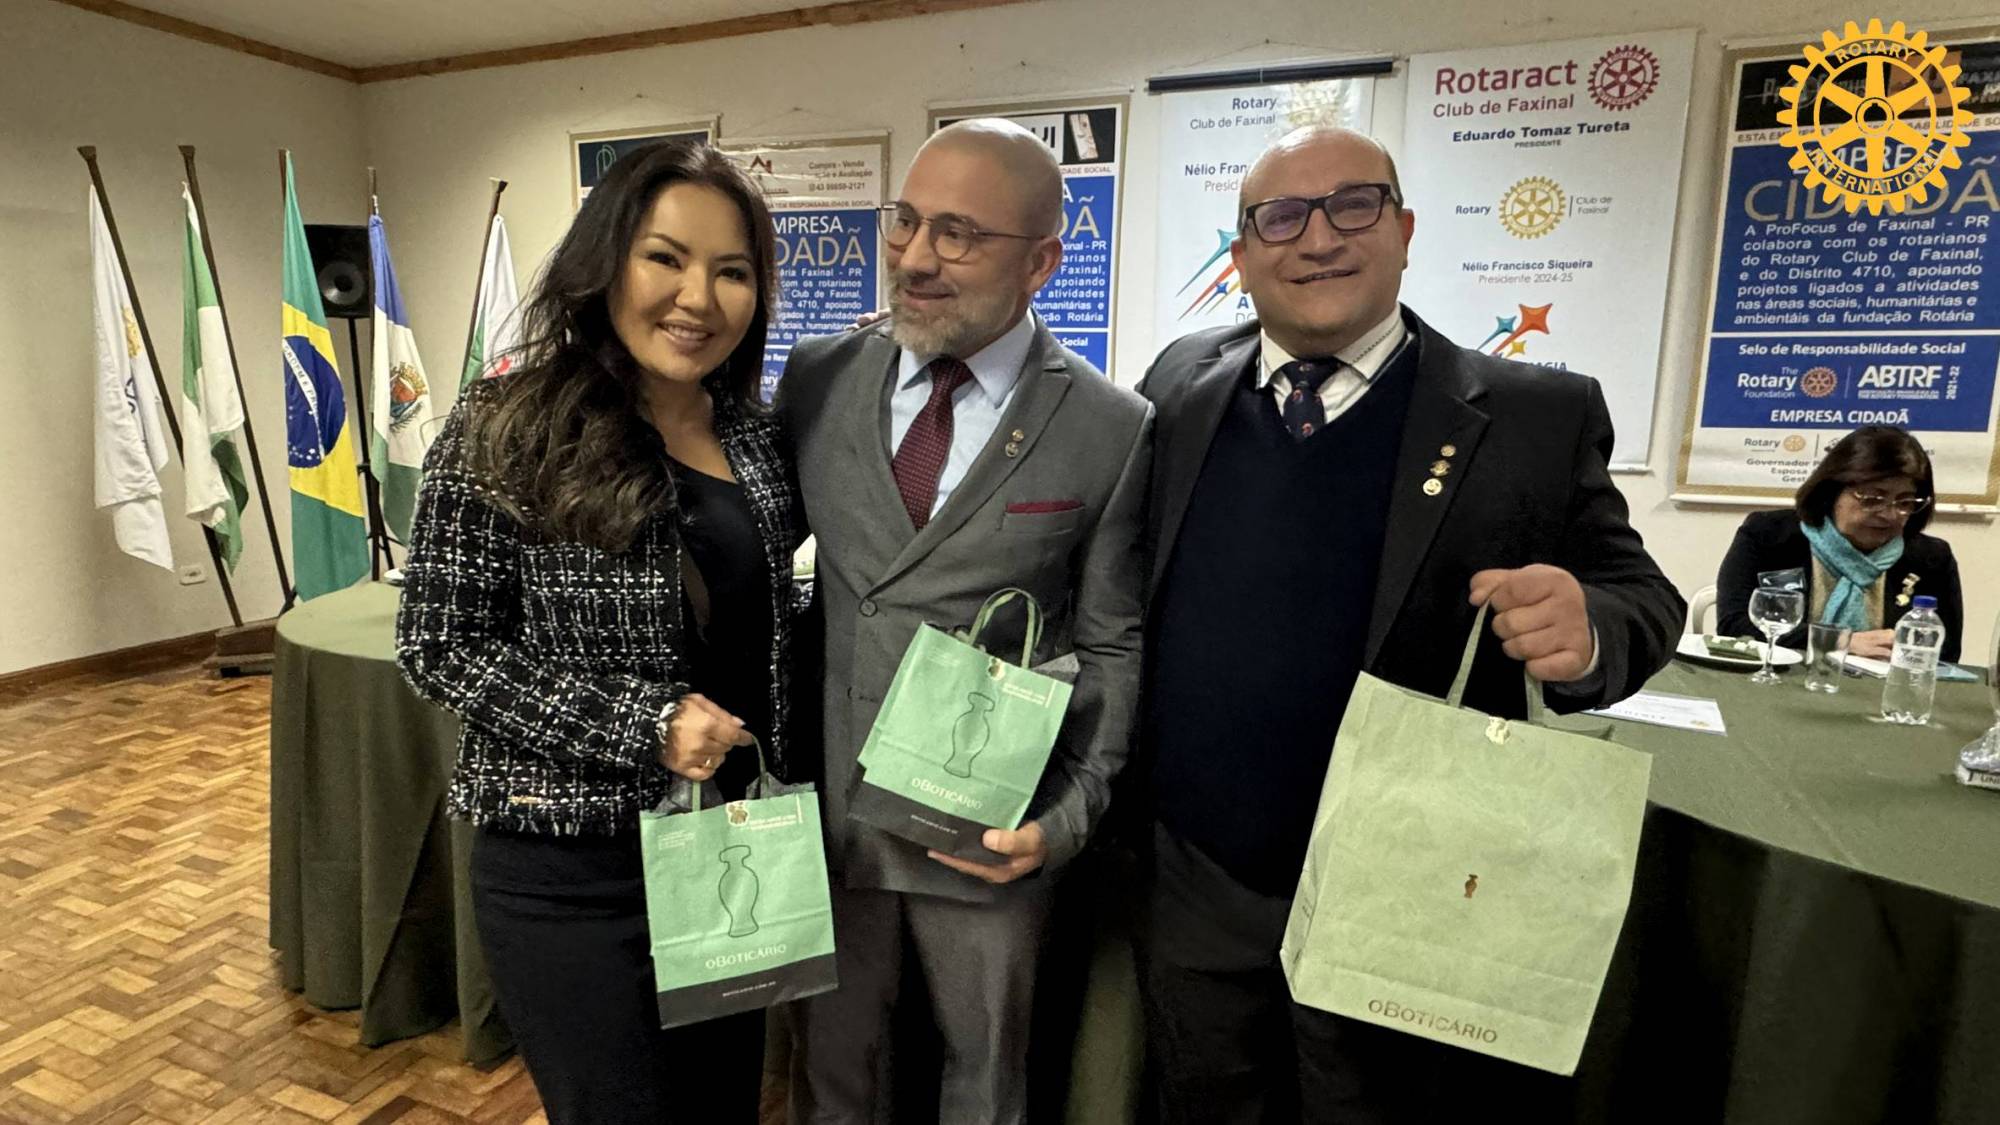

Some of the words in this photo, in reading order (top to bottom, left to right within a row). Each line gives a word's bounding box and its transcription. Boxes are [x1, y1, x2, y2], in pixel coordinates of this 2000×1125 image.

[1435, 59, 1578, 96] Rotaract
[1232, 96, 1278, 111] Rotary
[1433, 102, 1474, 118] Club
[1480, 100, 1501, 115] de
[1507, 94, 1574, 113] Faxinal
[1190, 117, 1215, 130] Club
[1217, 115, 1233, 129] de
[1235, 112, 1276, 127] Faxinal
[1452, 129, 1516, 143] Eduardo
[1520, 124, 1572, 139] Tomaz
[1577, 120, 1630, 135] Tureta
[1514, 139, 1562, 149] PRESIDENTE
[1083, 166, 1112, 174] SOCIAL
[1184, 163, 1216, 177] Nélio
[1204, 179, 1239, 192] Presid
[1575, 196, 1598, 205] Club
[1599, 196, 1613, 204] de
[1455, 204, 1491, 216] Rotary
[1577, 206, 1610, 215] Faxinal
[772, 215, 844, 235] MPRESA
[1744, 225, 1756, 236] A
[1765, 222, 1837, 235] ProFocus
[1847, 220, 1868, 233] de
[1878, 217, 1936, 231] Faxinal
[1964, 215, 1990, 228] PR
[773, 226, 867, 267] DADÃ
[1091, 240, 1106, 251] PR
[1743, 238, 1812, 252] colabora
[1823, 238, 1857, 250] com
[1868, 236, 1888, 247] os
[1899, 232, 1987, 246] rotarianos
[1062, 253, 1106, 263] arianos
[1741, 254, 1760, 266] do
[1770, 252, 1820, 267] Rotary
[1842, 250, 1878, 263] Club
[1888, 249, 1909, 261] de
[1920, 247, 1984, 262] Faxinal,
[1061, 265, 1106, 276] Faxinal,
[1461, 262, 1489, 272] Nélio
[1491, 260, 1545, 271] Francisco
[1547, 259, 1593, 272] Siqueira
[801, 268, 834, 277] Faxinal
[848, 268, 862, 277] PR
[1478, 274, 1532, 284] Presidente
[1533, 273, 1574, 284] 2024-25
[1739, 271, 1749, 282] e
[1759, 268, 1778, 281] do
[1788, 266, 1842, 280] Distrito
[1851, 264, 1896, 279] 4710,
[1907, 263, 1983, 278] apoiando
[781, 280, 798, 288] com
[803, 280, 814, 288] os
[818, 279, 863, 288] rotarianos
[1055, 276, 1106, 289] apoiando
[1737, 282, 1798, 298] projetos
[1808, 281, 1864, 296] ligados
[1874, 282, 1886, 293] a
[1896, 278, 1979, 293] atividades
[791, 289, 810, 299] Club
[814, 289, 825, 298] de
[829, 289, 862, 299] Faxinal,
[1048, 288, 1105, 298] atividades
[797, 301, 819, 310] 4710,
[824, 301, 863, 311] apoiando
[1033, 300, 1092, 311] humanitárias
[1097, 302, 1105, 310] e
[1237, 296, 1250, 309] A
[1735, 299, 1761, 310] nas
[1765, 296, 1804, 310] áreas
[1808, 296, 1862, 310] sociais,
[1865, 294, 1963, 308] humanitárias
[1966, 295, 1977, 307] e
[1067, 311, 1104, 323] Rotária
[1816, 311, 1836, 323] da
[1842, 309, 1912, 325] fundação
[1919, 309, 1975, 322] Rotária
[1063, 338, 1089, 348] Social
[1738, 343, 1768, 356] Selo
[1770, 343, 1789, 356] de
[1791, 342, 1918, 357] Responsabilidade
[1921, 341, 1967, 355] Social
[1781, 366, 1799, 376] The
[1737, 371, 1798, 392] Rotary
[1857, 365, 1943, 388] ABTRF
[1945, 365, 1961, 400] 2021-22
[1743, 389, 1796, 399] Foundation
[1770, 409, 1843, 424] EMPRESA
[1847, 408, 1910, 424] CIDADÃ
[1744, 437, 1781, 448] Rotary
[1746, 457, 1810, 467] Governador
[1771, 467, 1808, 476] Esposa
